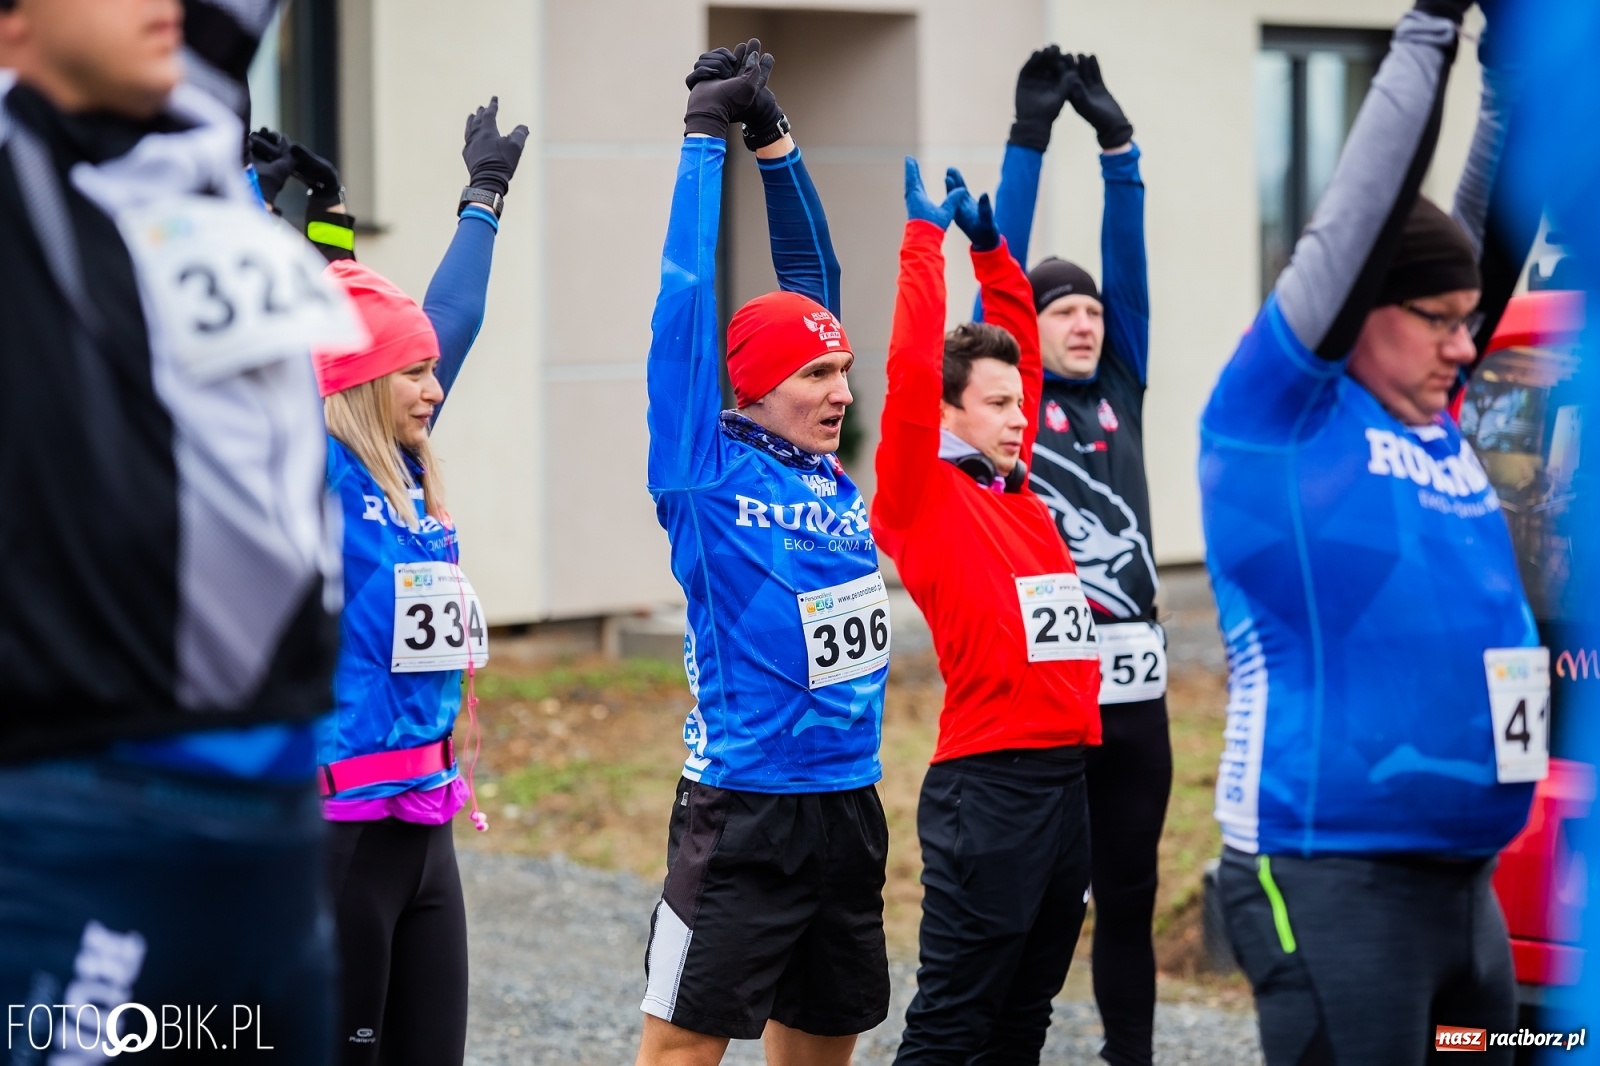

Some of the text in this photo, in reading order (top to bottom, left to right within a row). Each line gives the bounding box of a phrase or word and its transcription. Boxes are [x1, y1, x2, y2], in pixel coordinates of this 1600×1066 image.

[784, 538, 815, 551] EKO
[828, 539, 860, 552] OKNA
[404, 601, 484, 651] 334
[813, 608, 888, 668] 396
[1100, 651, 1160, 685] 52
